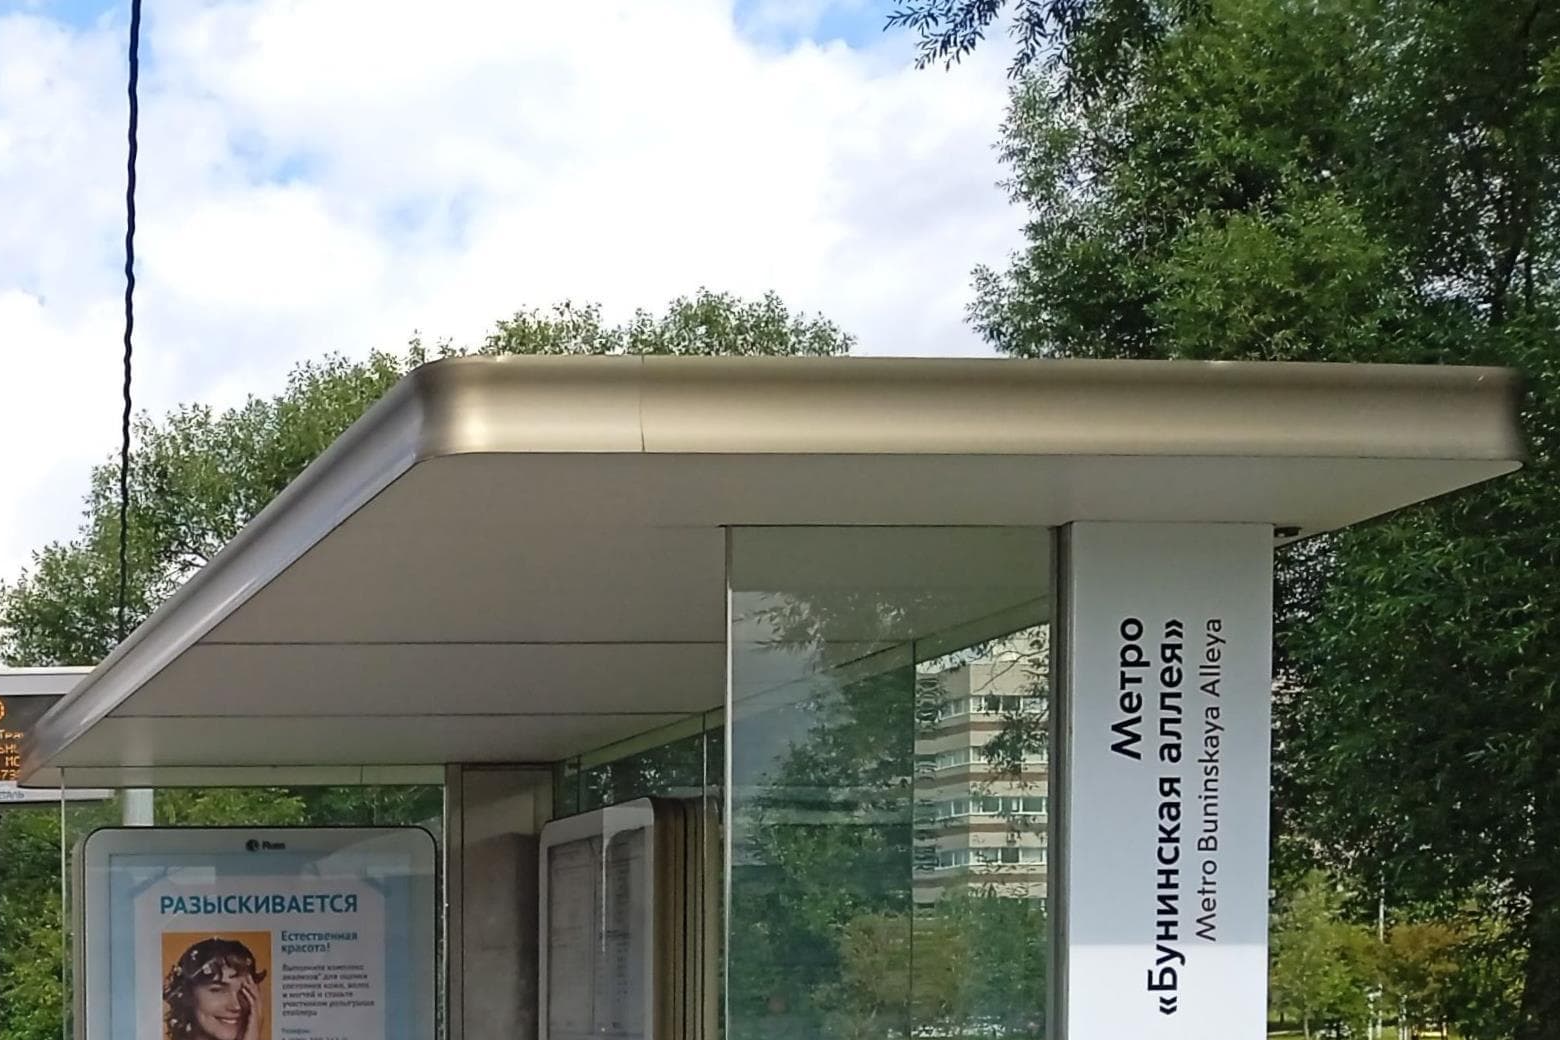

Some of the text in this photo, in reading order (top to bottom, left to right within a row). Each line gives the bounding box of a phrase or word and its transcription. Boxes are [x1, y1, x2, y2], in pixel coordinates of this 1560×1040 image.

[1111, 617, 1151, 761] Метро
[1147, 619, 1186, 1016] «Бунинская аллея»
[1196, 618, 1227, 942] Metro Buninskaya Alleya
[160, 894, 358, 914] РАЗЫСКИВАЕТСЯ
[281, 930, 358, 942] Естественная
[281, 942, 331, 954] красота!
